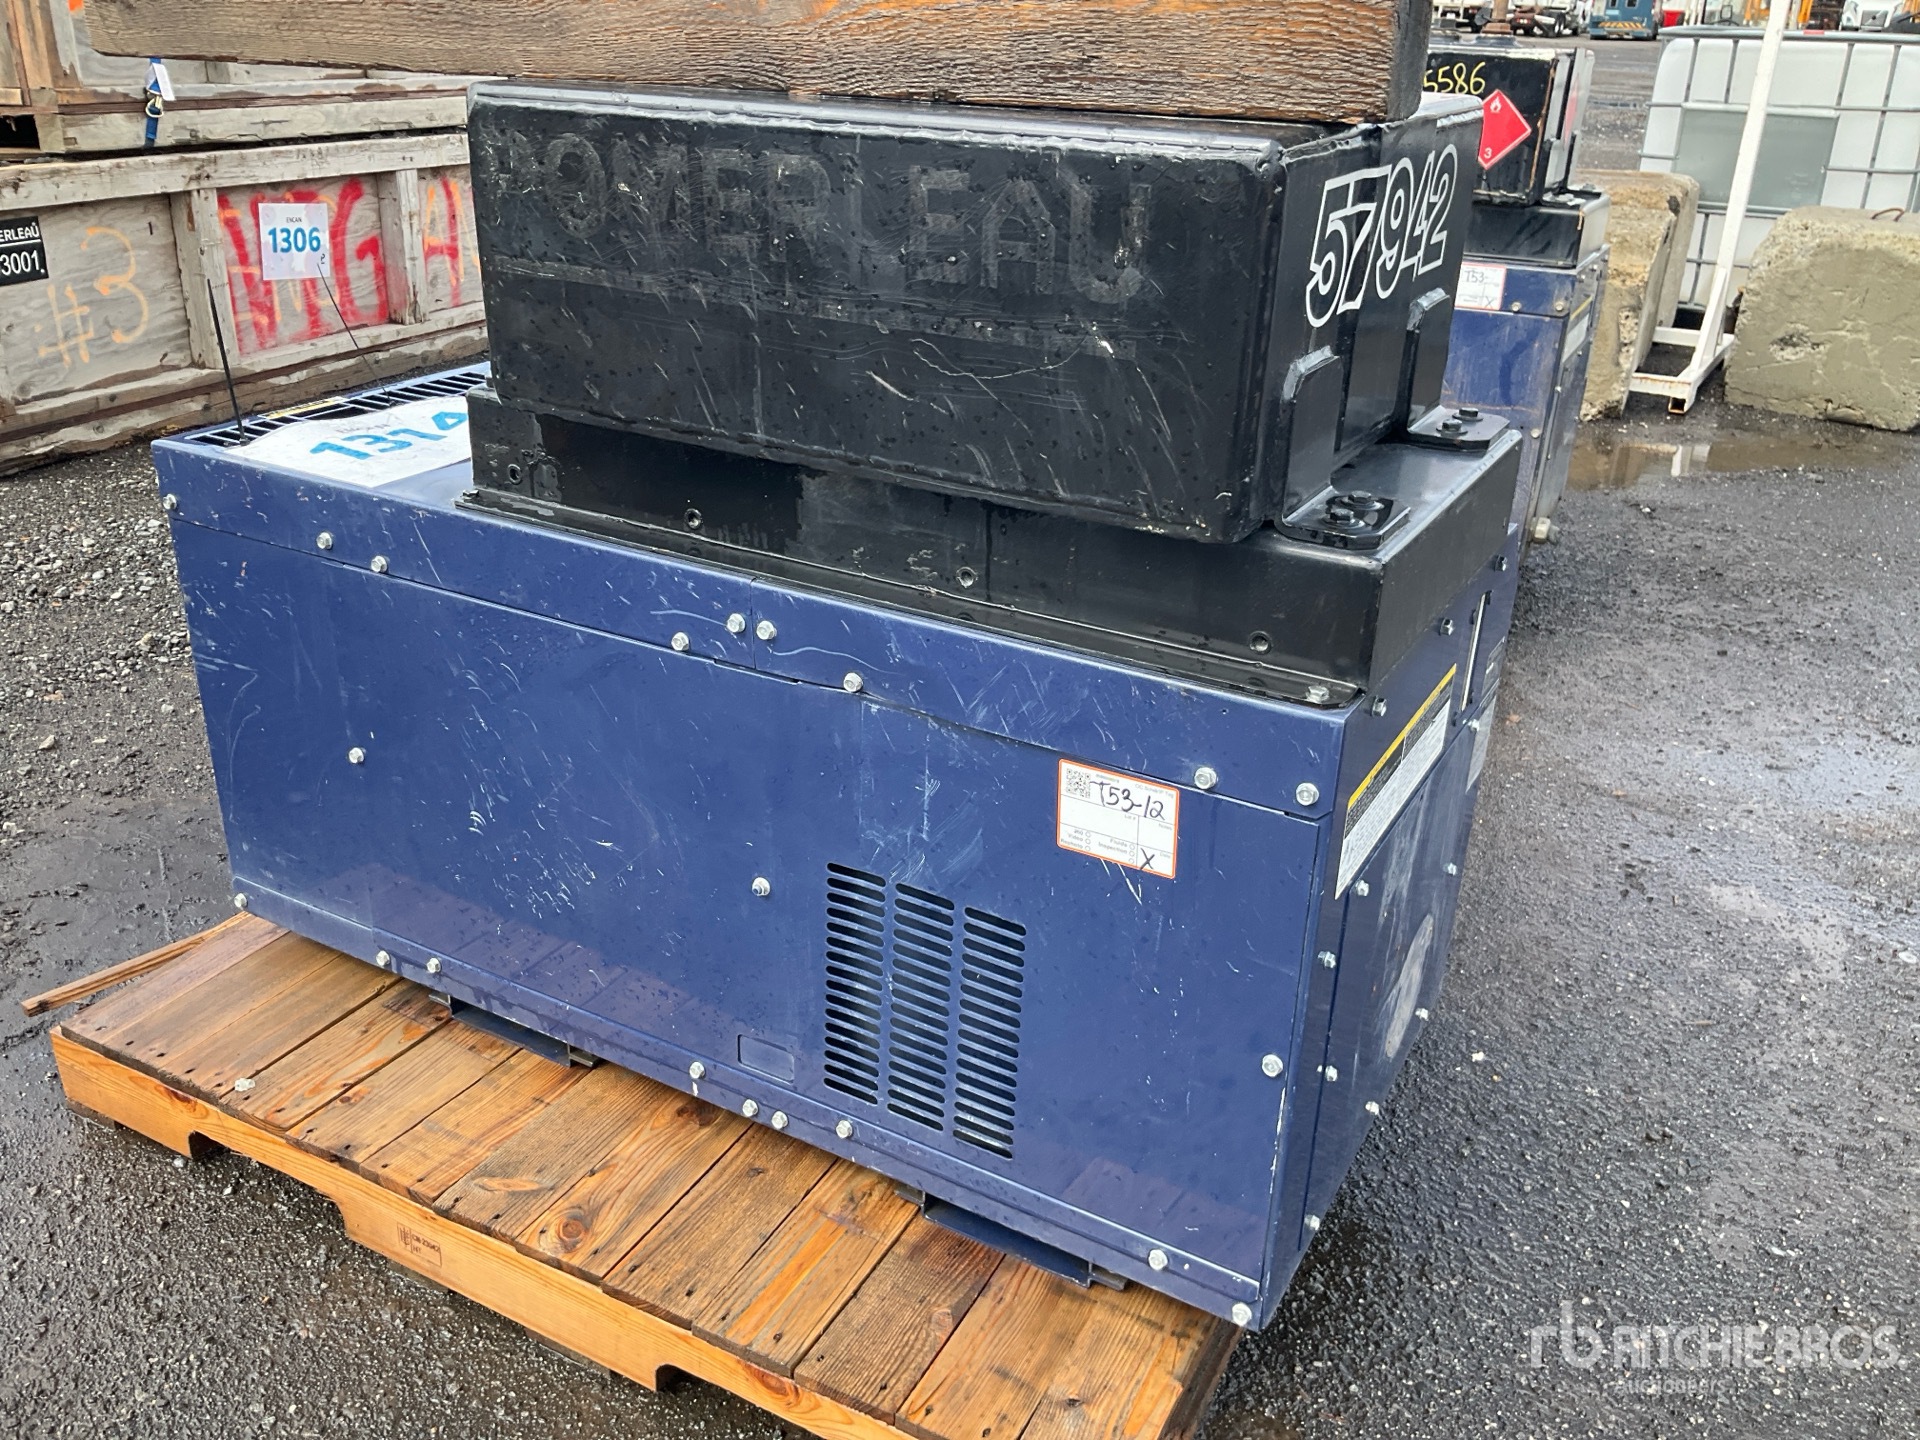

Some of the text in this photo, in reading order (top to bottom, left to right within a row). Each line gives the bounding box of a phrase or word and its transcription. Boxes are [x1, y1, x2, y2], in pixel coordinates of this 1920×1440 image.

[1423, 61, 1486, 95] 5586
[1483, 147, 1493, 159] 3
[268, 227, 321, 253] 1306
[1305, 143, 1458, 328] 57942
[37, 226, 149, 366] #3
[309, 411, 467, 460] 1314
[1090, 781, 1165, 820] T53-12
[1140, 848, 1155, 870] X
